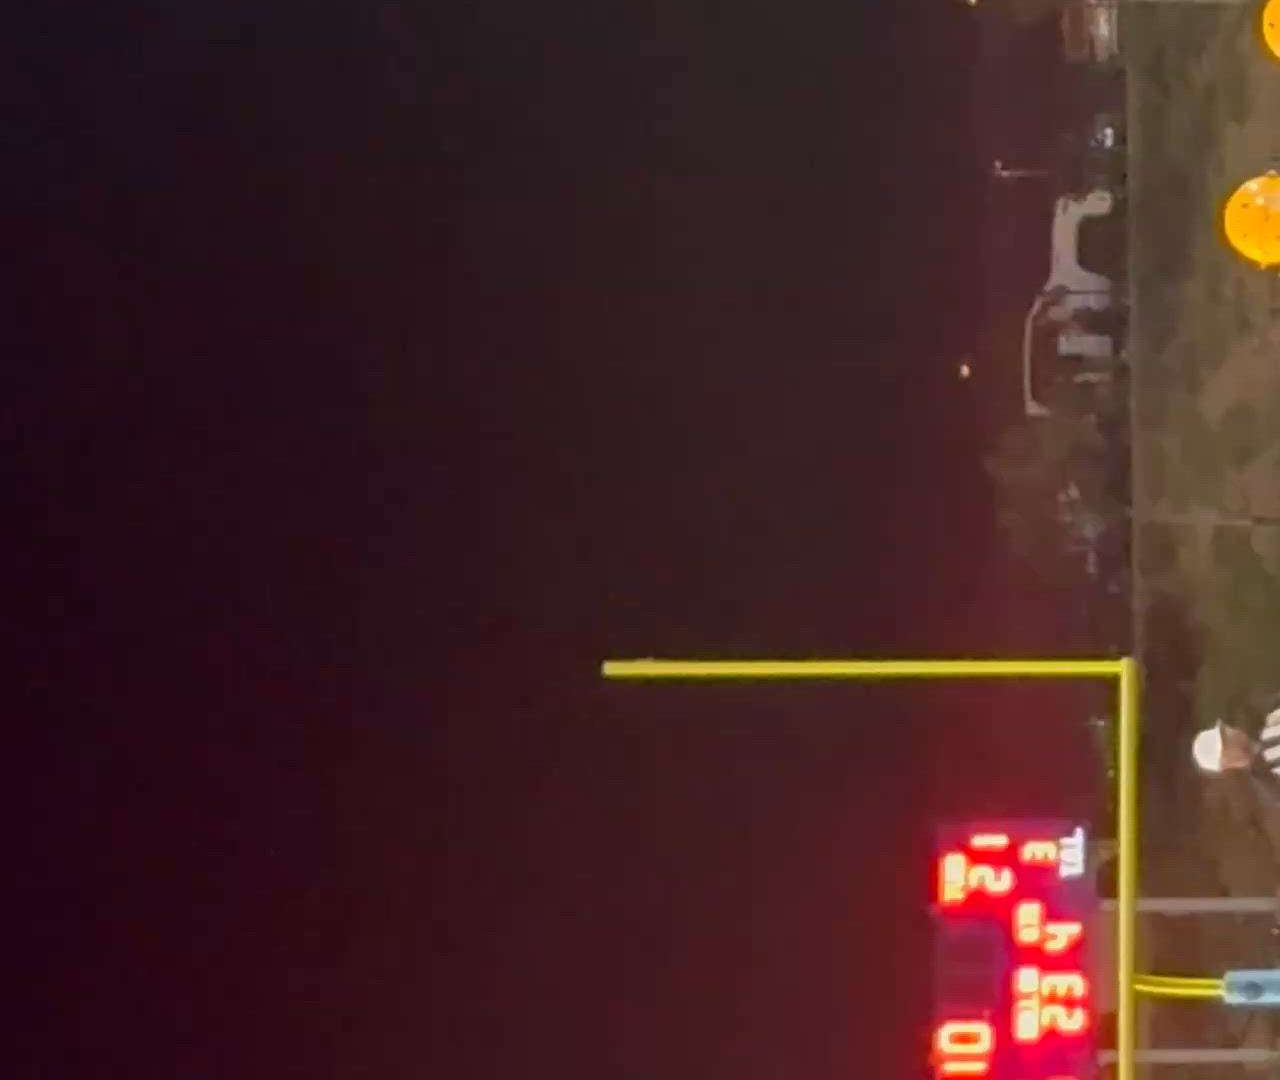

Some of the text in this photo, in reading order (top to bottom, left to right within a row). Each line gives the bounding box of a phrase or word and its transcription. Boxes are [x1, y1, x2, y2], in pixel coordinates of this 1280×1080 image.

[1021, 841, 1057, 861] 3
[1043, 923, 1082, 951] 4
[1041, 974, 1085, 1031] 23
